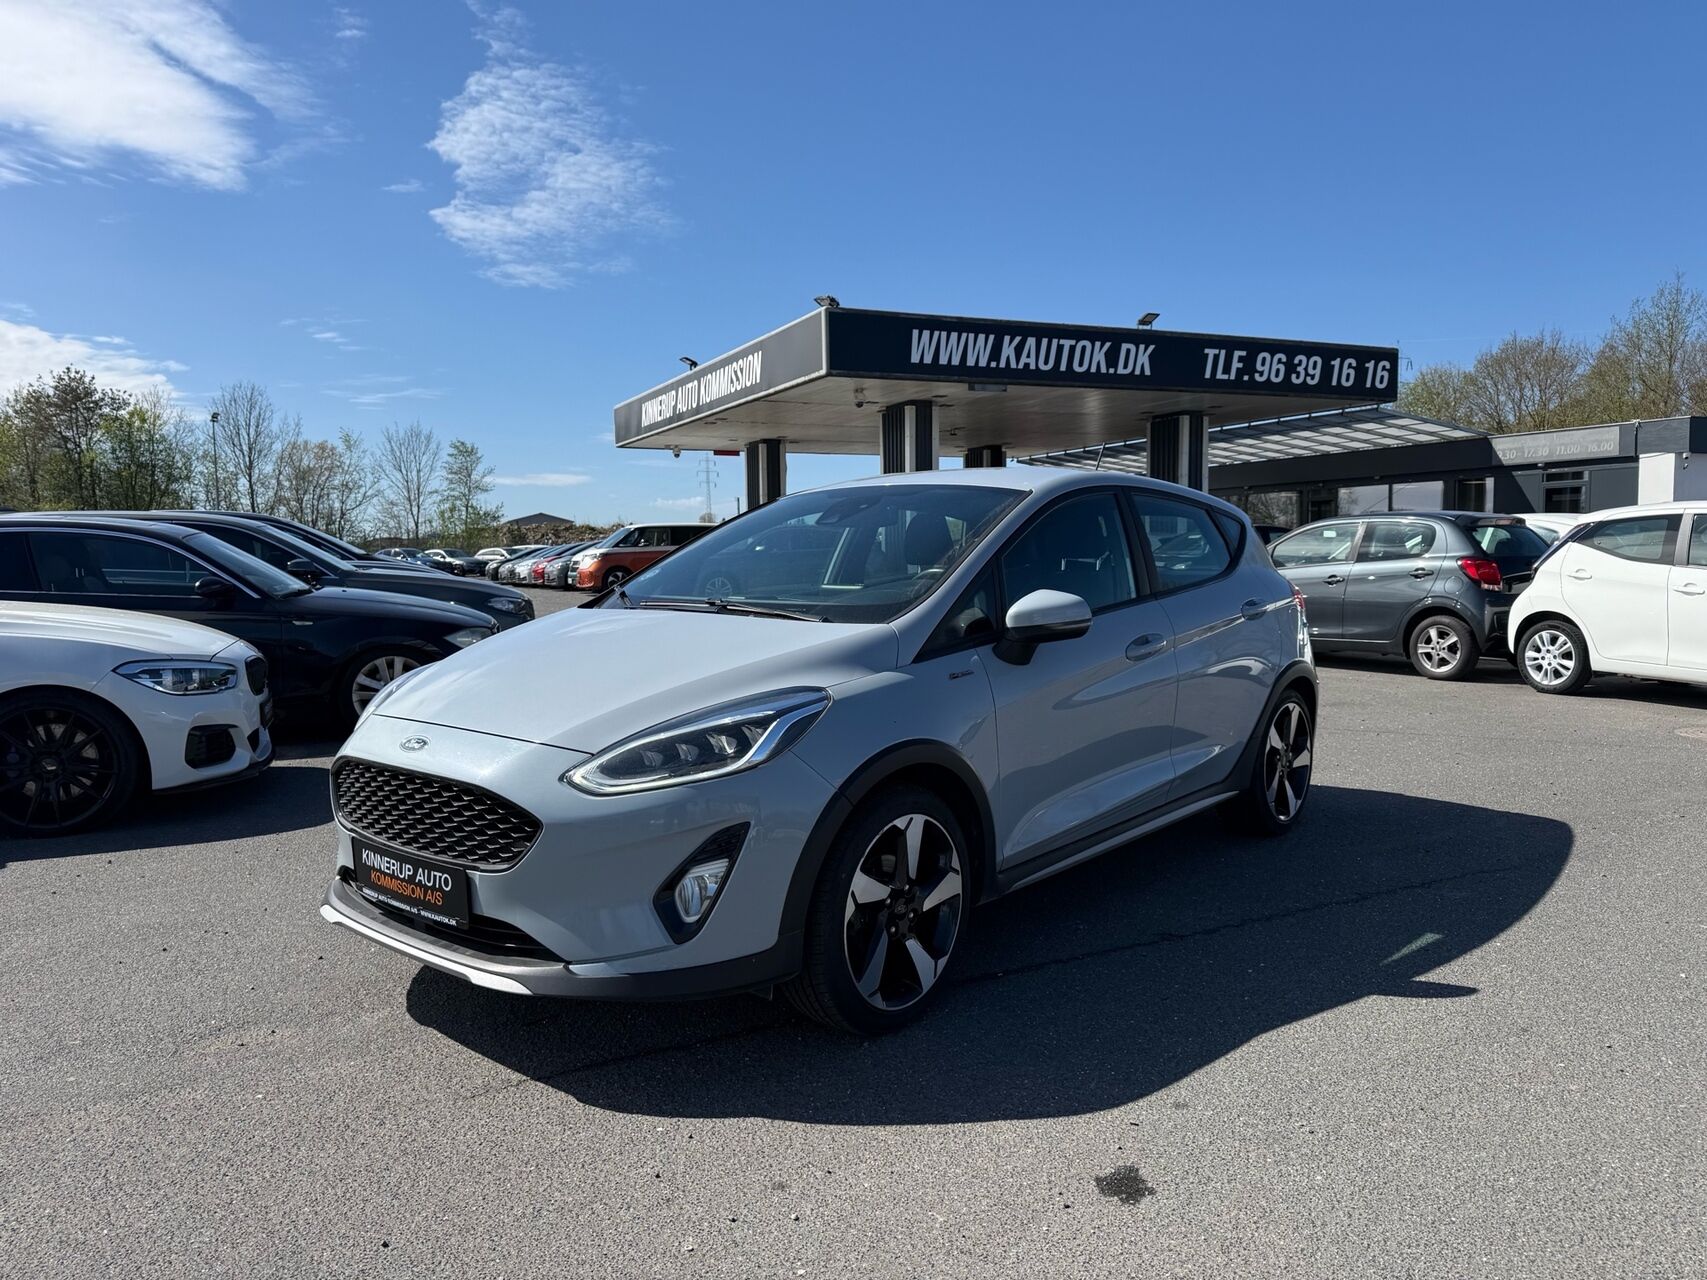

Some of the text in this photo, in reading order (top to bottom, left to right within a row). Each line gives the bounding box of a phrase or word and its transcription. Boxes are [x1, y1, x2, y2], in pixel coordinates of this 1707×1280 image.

[910, 329, 1155, 375] WWW.KAUTOK.DK
[1203, 348, 1391, 389] TLF. 96 39 16 16
[641, 350, 762, 428] KINNERUP AUTO KOMMISSION
[1556, 444, 1580, 455] 11.00
[362, 848, 452, 892] KINNERUP AUTO
[371, 869, 443, 905] KOMMISSION A/S
